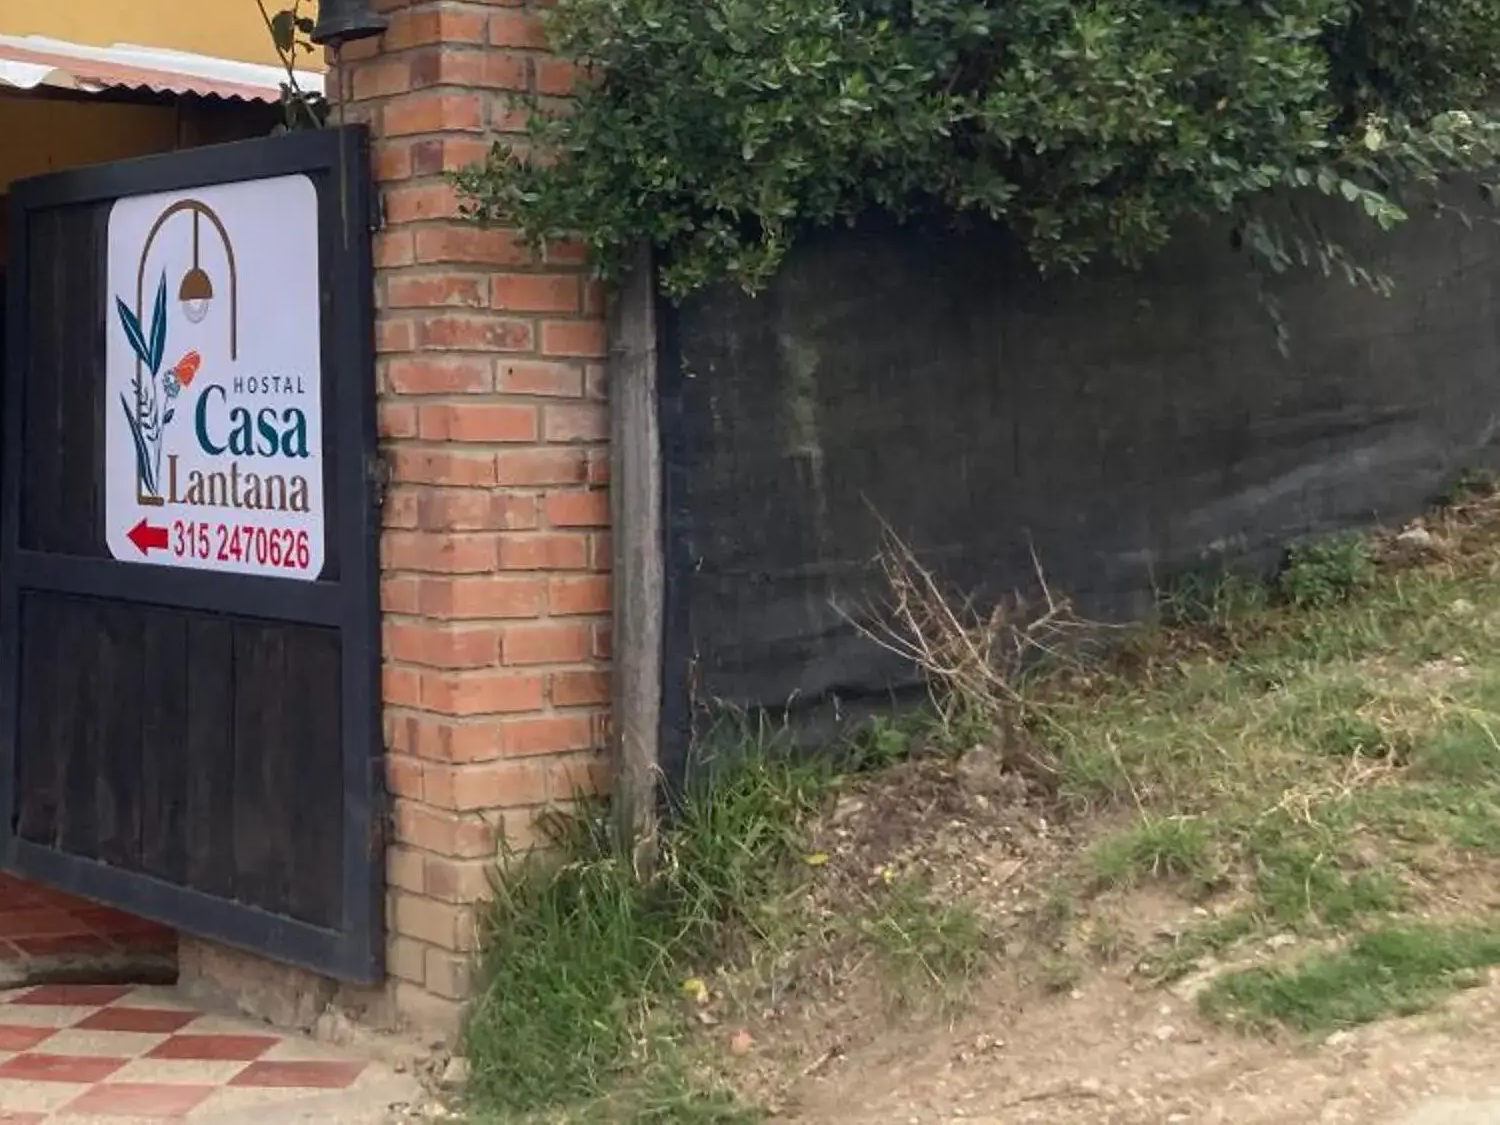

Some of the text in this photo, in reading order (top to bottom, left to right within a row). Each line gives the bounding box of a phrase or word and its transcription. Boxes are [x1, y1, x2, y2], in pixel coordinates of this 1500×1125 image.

[234, 375, 305, 394] HOSTAL
[195, 384, 310, 458] Casa
[167, 454, 310, 512] Lantana
[173, 520, 310, 570] 315 2470626
